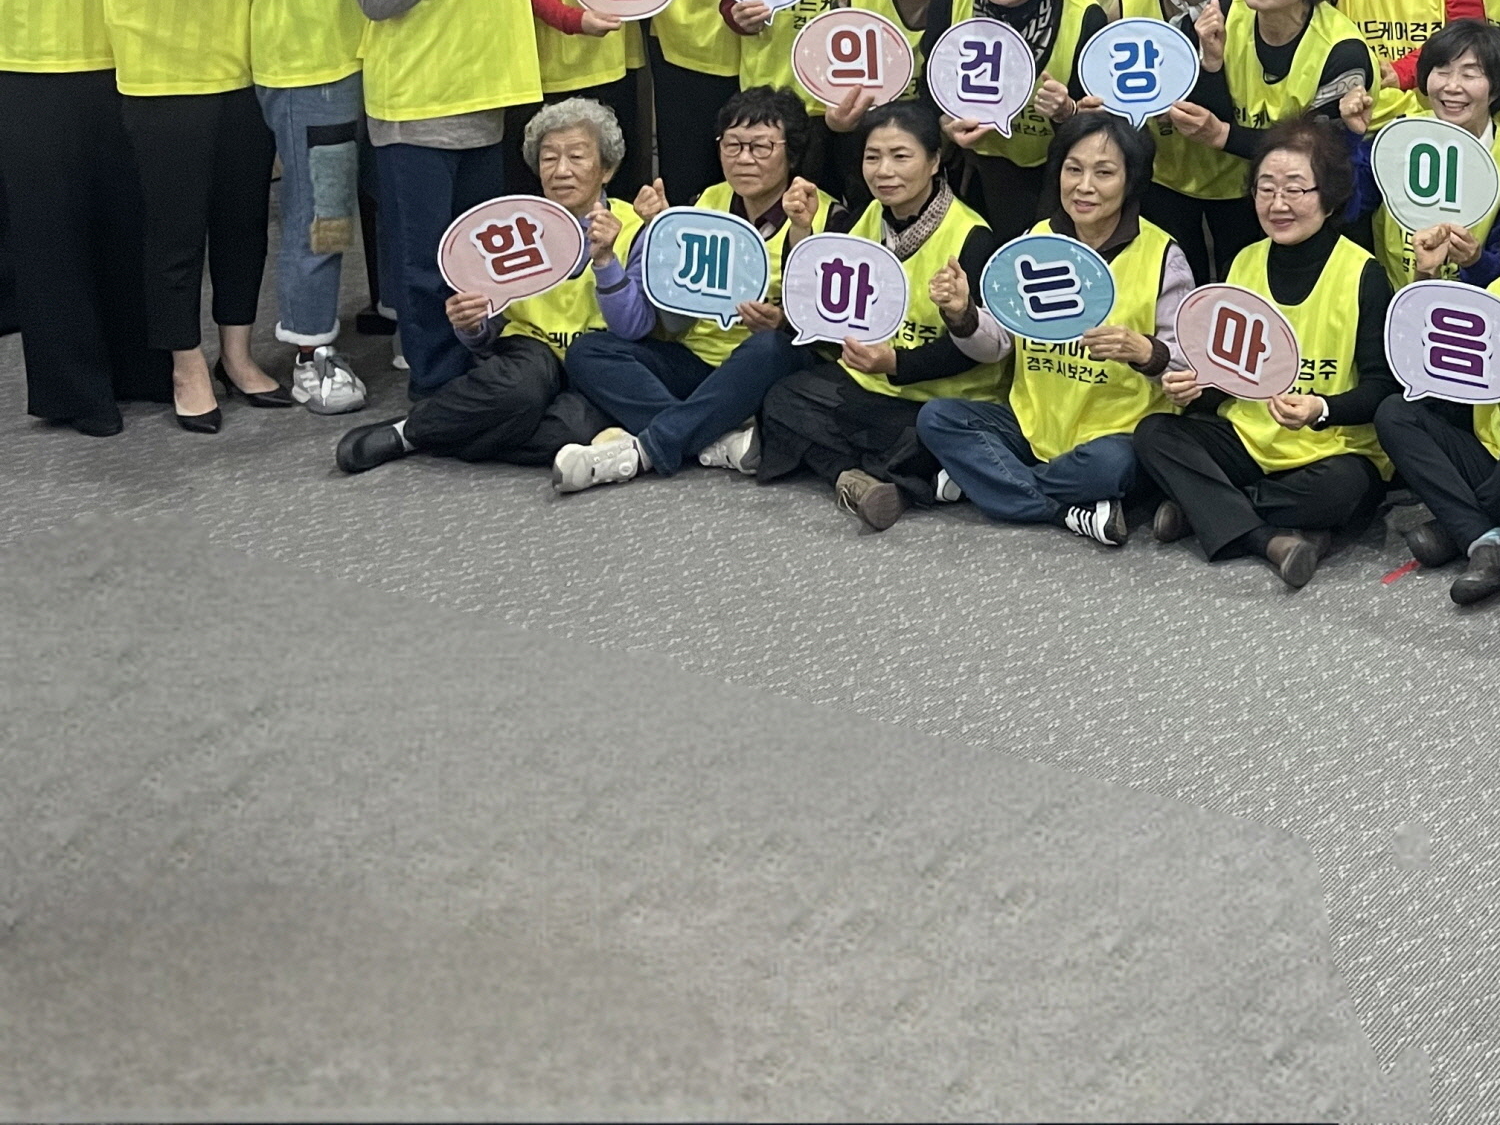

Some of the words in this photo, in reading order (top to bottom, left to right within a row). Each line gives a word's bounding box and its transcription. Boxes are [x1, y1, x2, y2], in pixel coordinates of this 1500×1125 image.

[829, 27, 880, 81] 의
[959, 39, 1002, 99] 건
[1112, 39, 1161, 98] 강
[1407, 141, 1460, 207] 이
[474, 215, 546, 279] 함
[679, 231, 732, 294] 께
[819, 256, 875, 322] 하
[1019, 259, 1083, 315] 는
[1027, 356, 1109, 385] 경주시보건소
[1213, 306, 1269, 377] 마
[1426, 305, 1489, 379] 음
